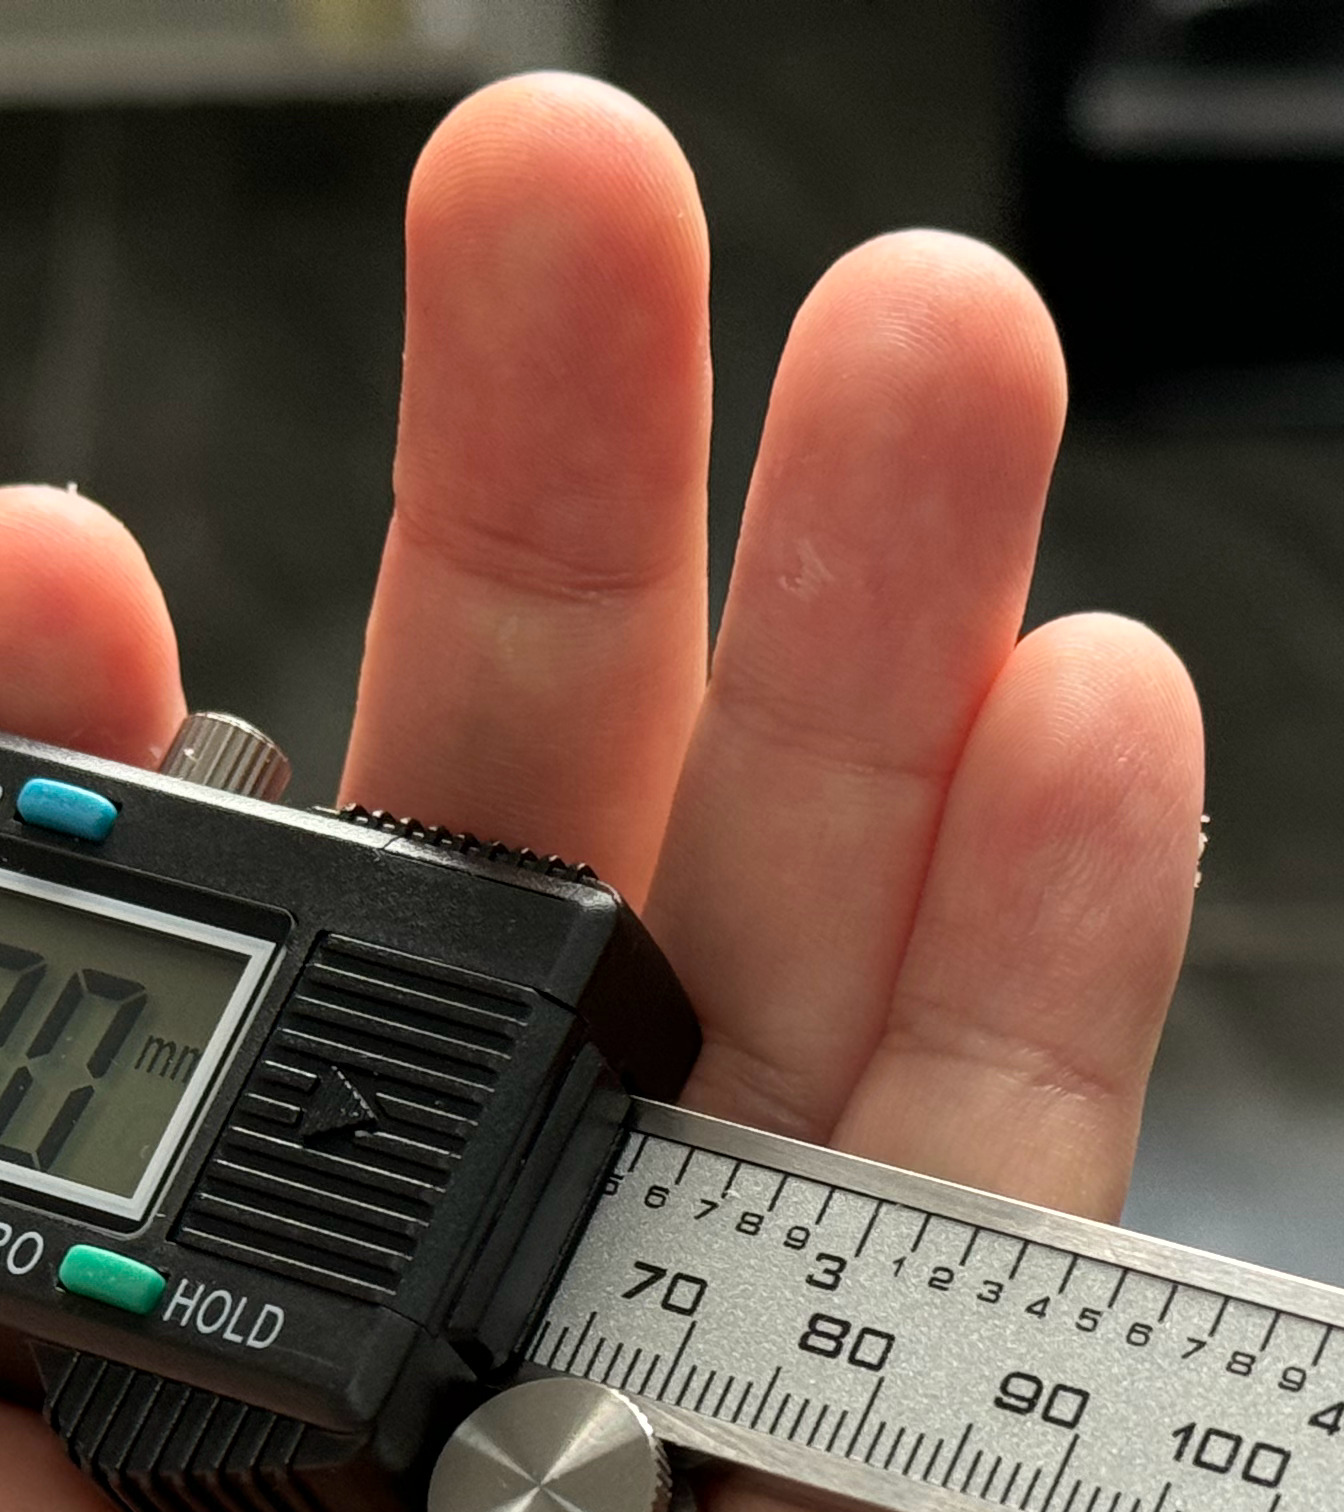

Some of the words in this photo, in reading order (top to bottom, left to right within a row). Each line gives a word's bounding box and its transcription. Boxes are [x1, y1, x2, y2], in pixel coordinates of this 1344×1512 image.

[162, 1278, 285, 1350] HOLD
[621, 1260, 708, 1317] 70
[797, 1312, 896, 1373] 80
[993, 1371, 1091, 1430] 90
[1171, 1421, 1292, 1489] 100
[643, 1184, 670, 1209] 6
[693, 1198, 719, 1221] 7
[734, 1211, 765, 1237] 8
[782, 1225, 811, 1251] 9
[805, 1252, 848, 1292] 3
[892, 1256, 907, 1278] 1
[927, 1266, 955, 1292] 2
[976, 1279, 1005, 1305] 3
[1024, 1295, 1051, 1320] 4
[1075, 1306, 1103, 1333] 5
[1125, 1321, 1154, 1347] 6
[1180, 1336, 1208, 1360] 7
[1225, 1350, 1257, 1378] 8
[1277, 1365, 1307, 1393] 9
